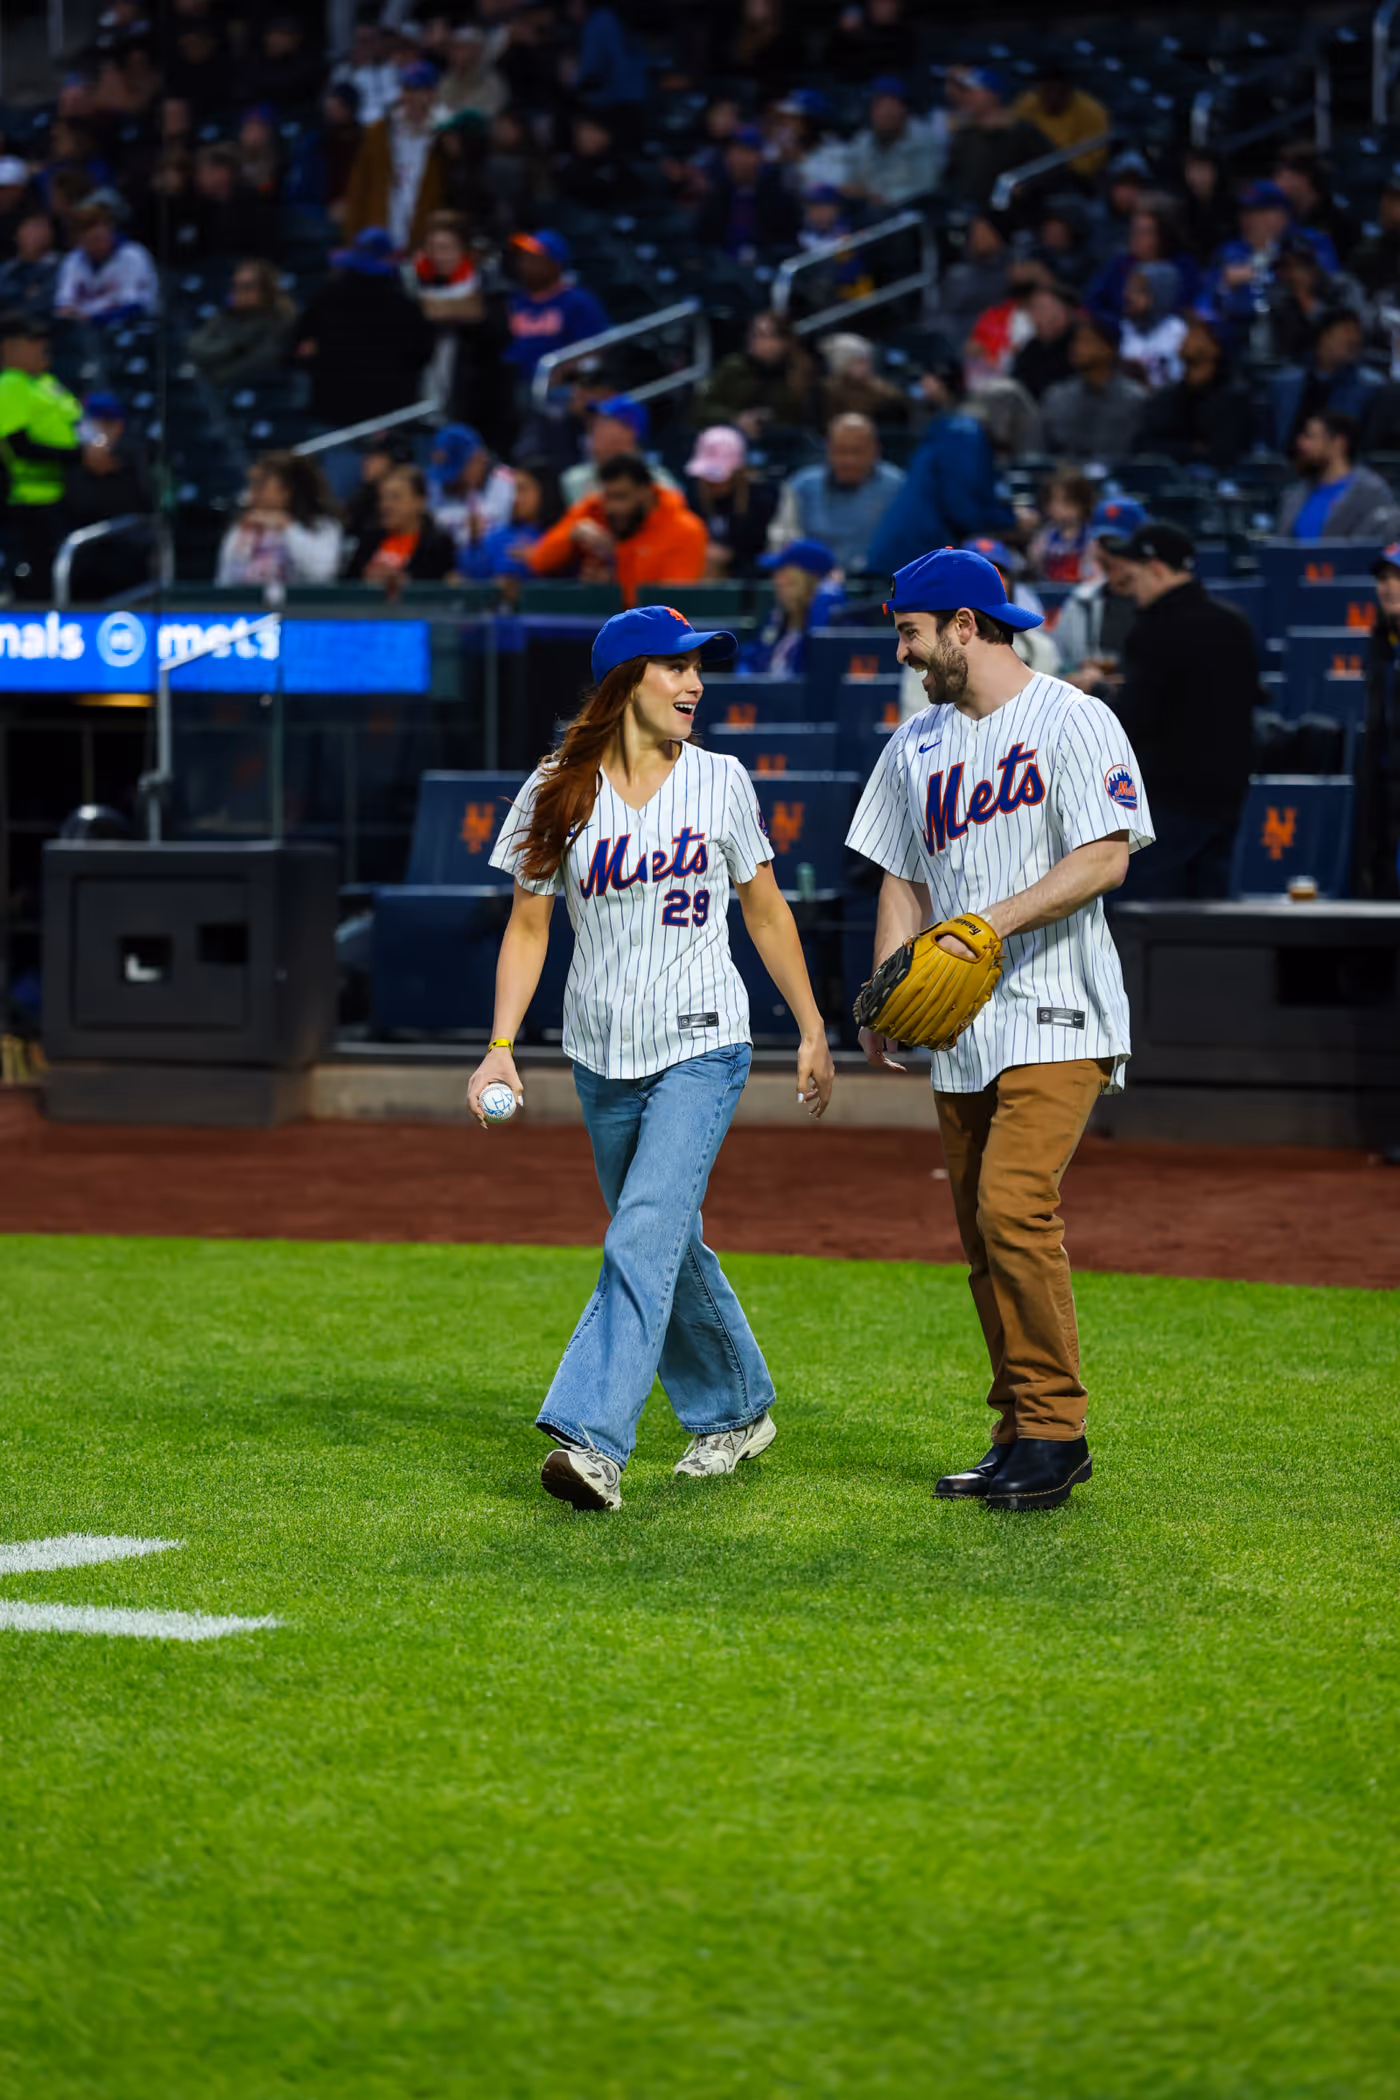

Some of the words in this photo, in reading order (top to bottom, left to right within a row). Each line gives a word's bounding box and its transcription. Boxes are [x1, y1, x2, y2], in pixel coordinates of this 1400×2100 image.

[0, 610, 85, 660] nals
[157, 616, 281, 660] mets
[922, 742, 1046, 856] Mets
[580, 826, 709, 900] Mets
[661, 889, 711, 927] 29
